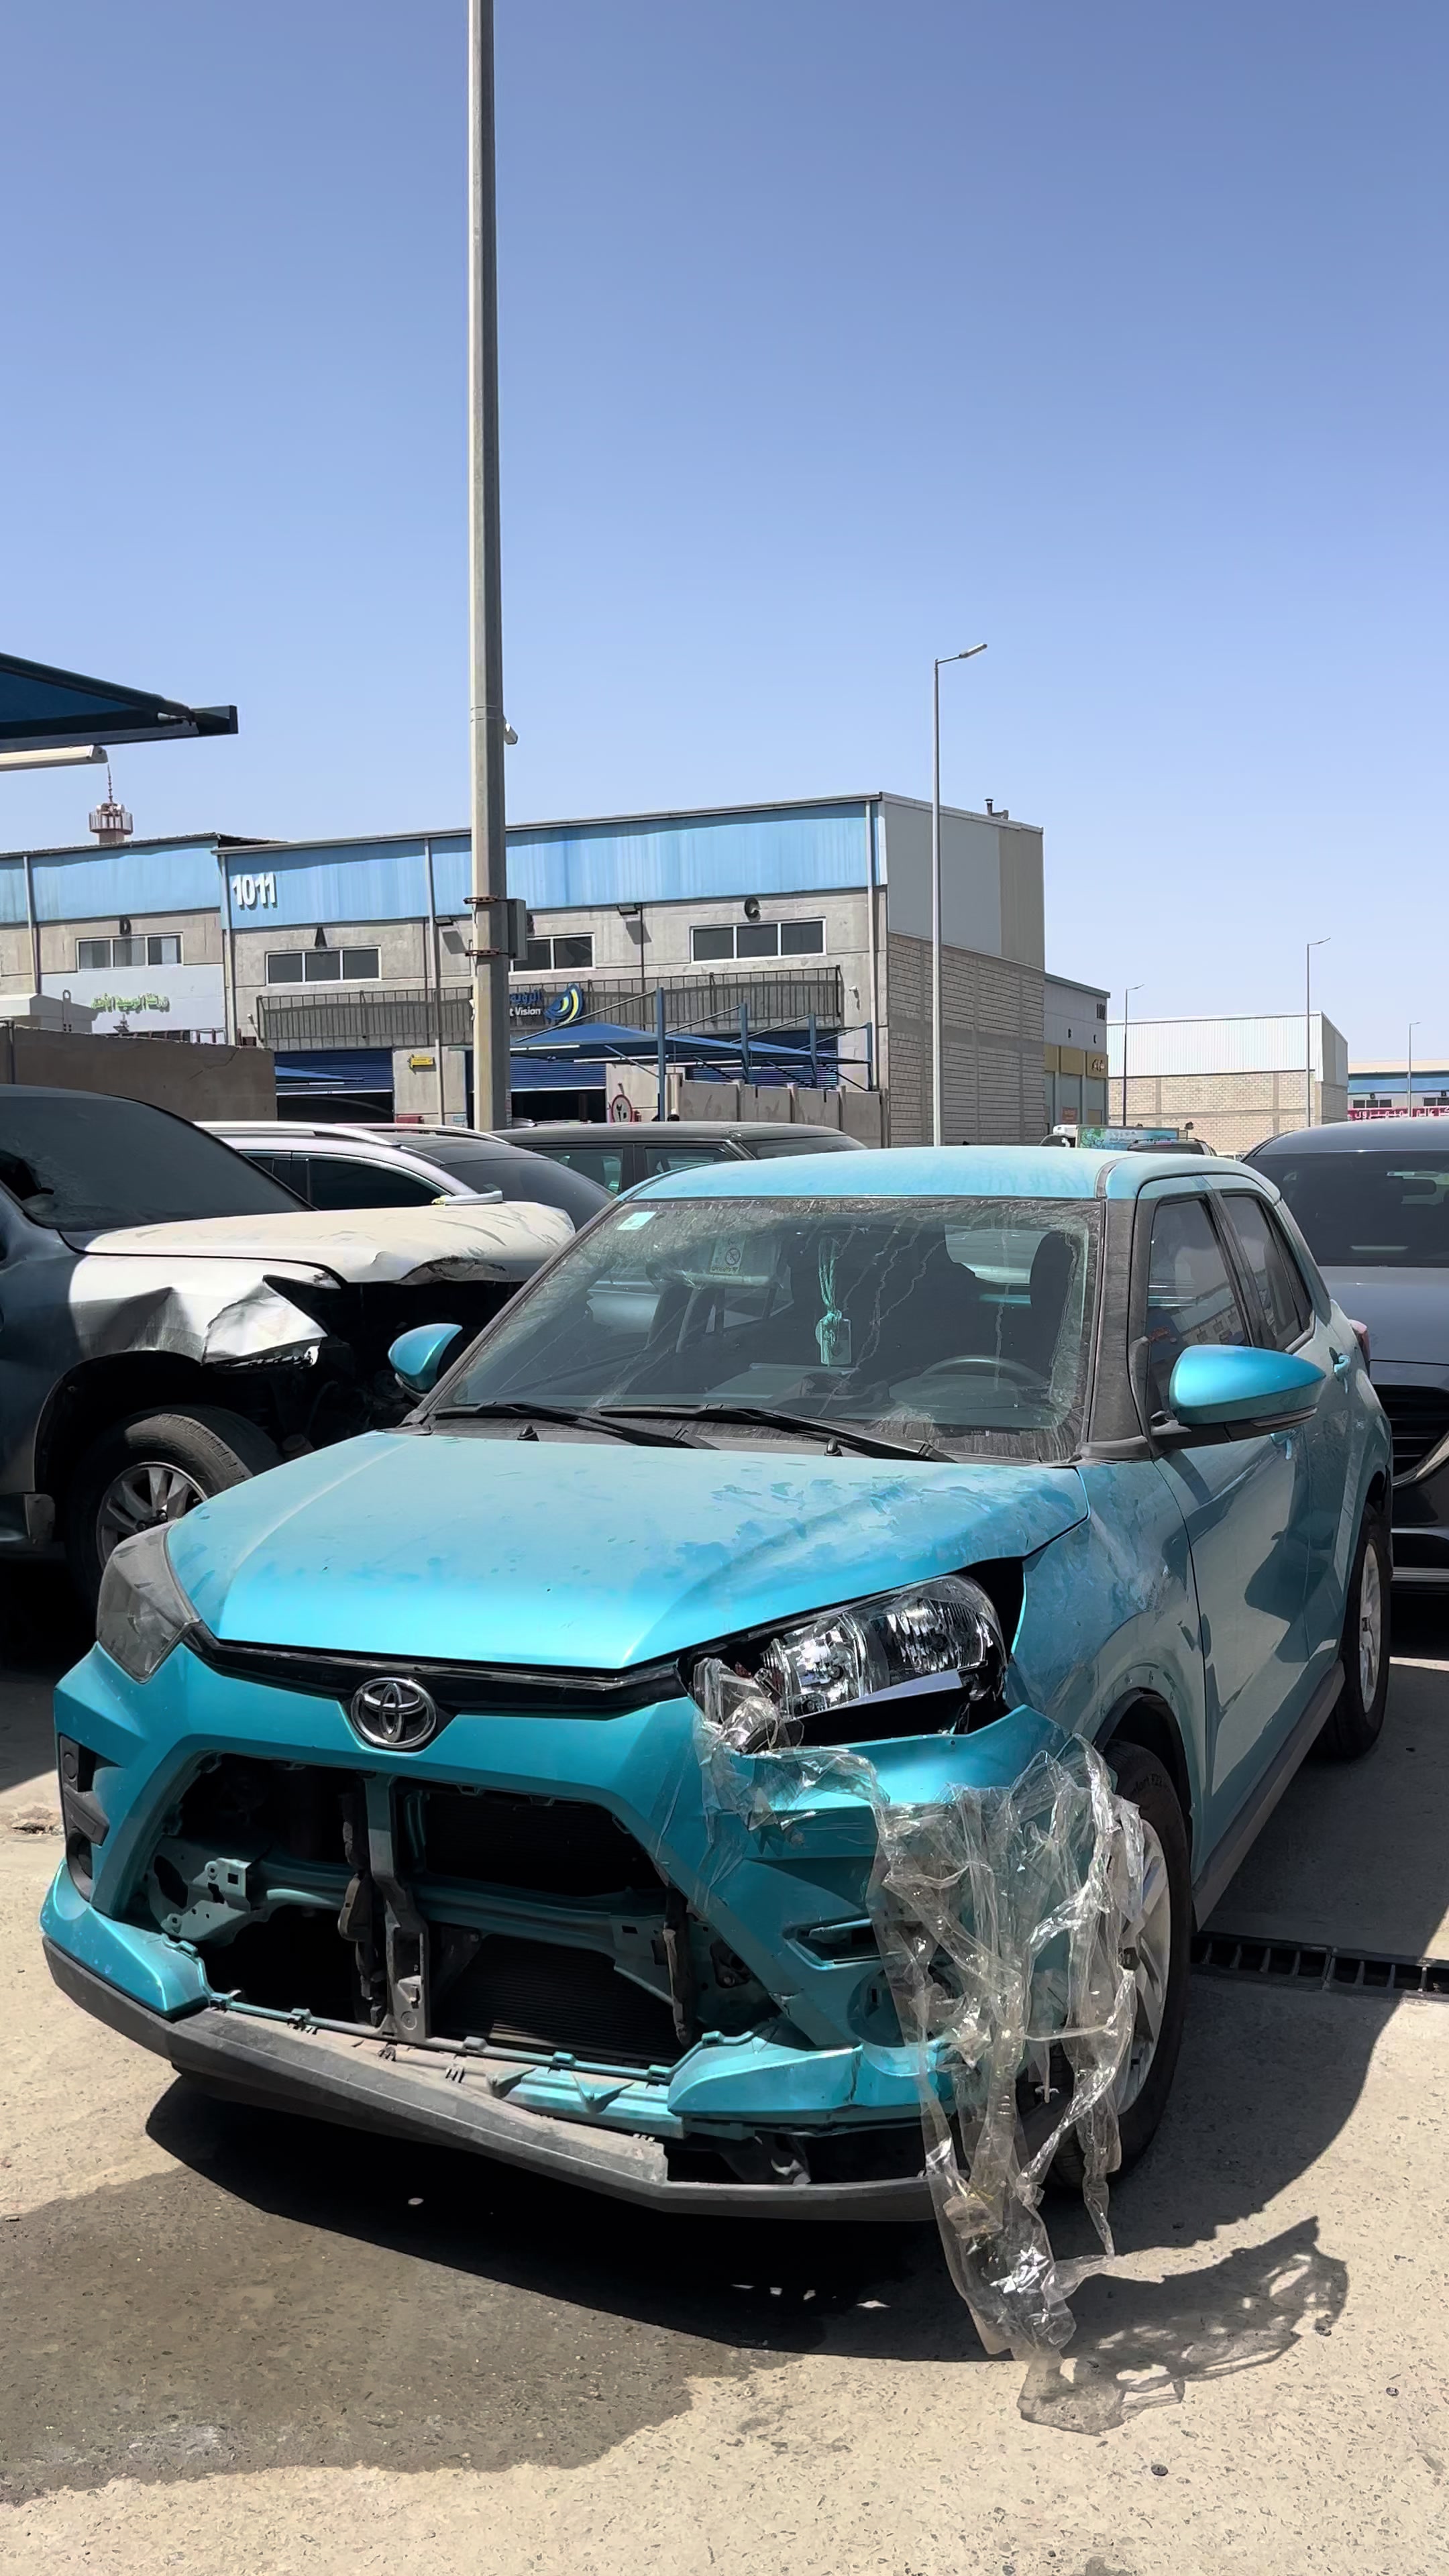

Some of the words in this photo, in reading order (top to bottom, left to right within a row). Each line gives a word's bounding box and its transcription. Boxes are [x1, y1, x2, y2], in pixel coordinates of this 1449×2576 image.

[232, 873, 276, 906] 1011
[745, 898, 759, 918] C
[119, 916, 131, 934] D
[314, 926, 327, 947] A
[515, 1007, 541, 1016] Vision
